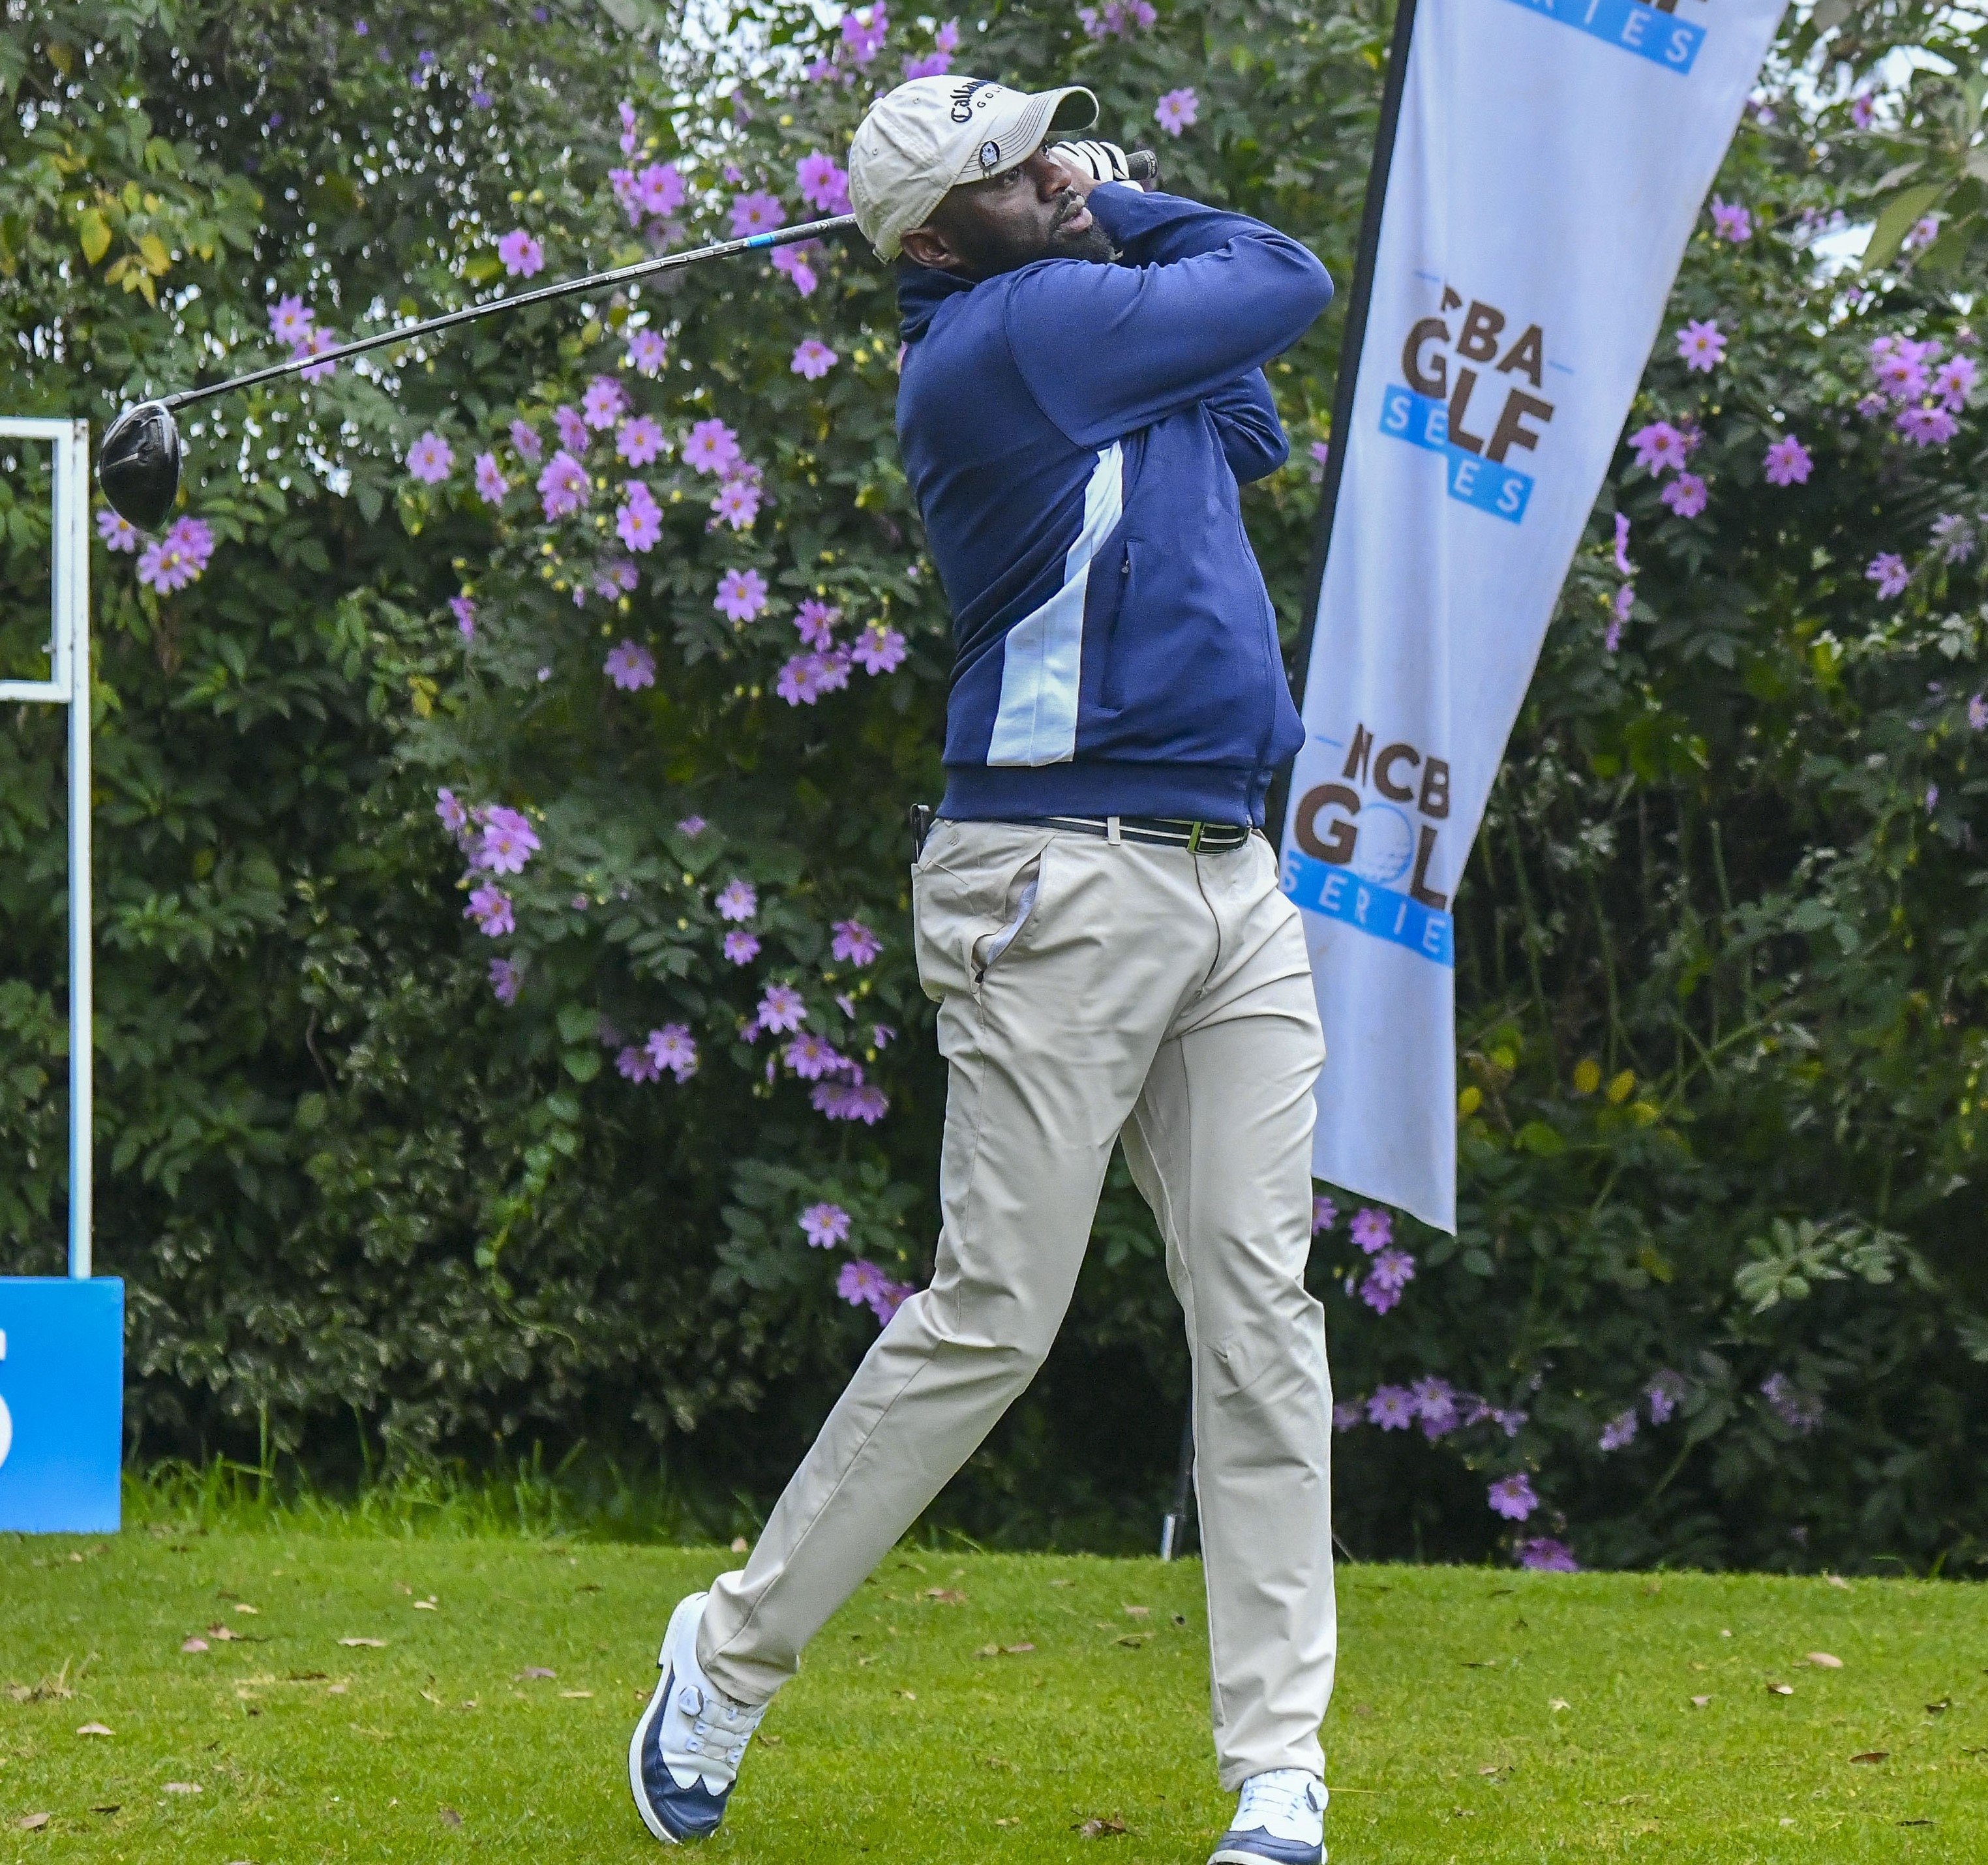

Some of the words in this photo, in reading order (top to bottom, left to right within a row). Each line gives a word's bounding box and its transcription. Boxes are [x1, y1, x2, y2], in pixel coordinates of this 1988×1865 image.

[1533, 0, 1693, 63] IES
[605, 246, 740, 281] TENSEI
[1441, 282, 1544, 389] BA
[1401, 317, 1555, 464] GLF
[1385, 395, 1524, 512] SEES
[1342, 723, 1450, 820] NCB
[1293, 783, 1448, 910] GOL
[1280, 861, 1447, 955] SERIE
